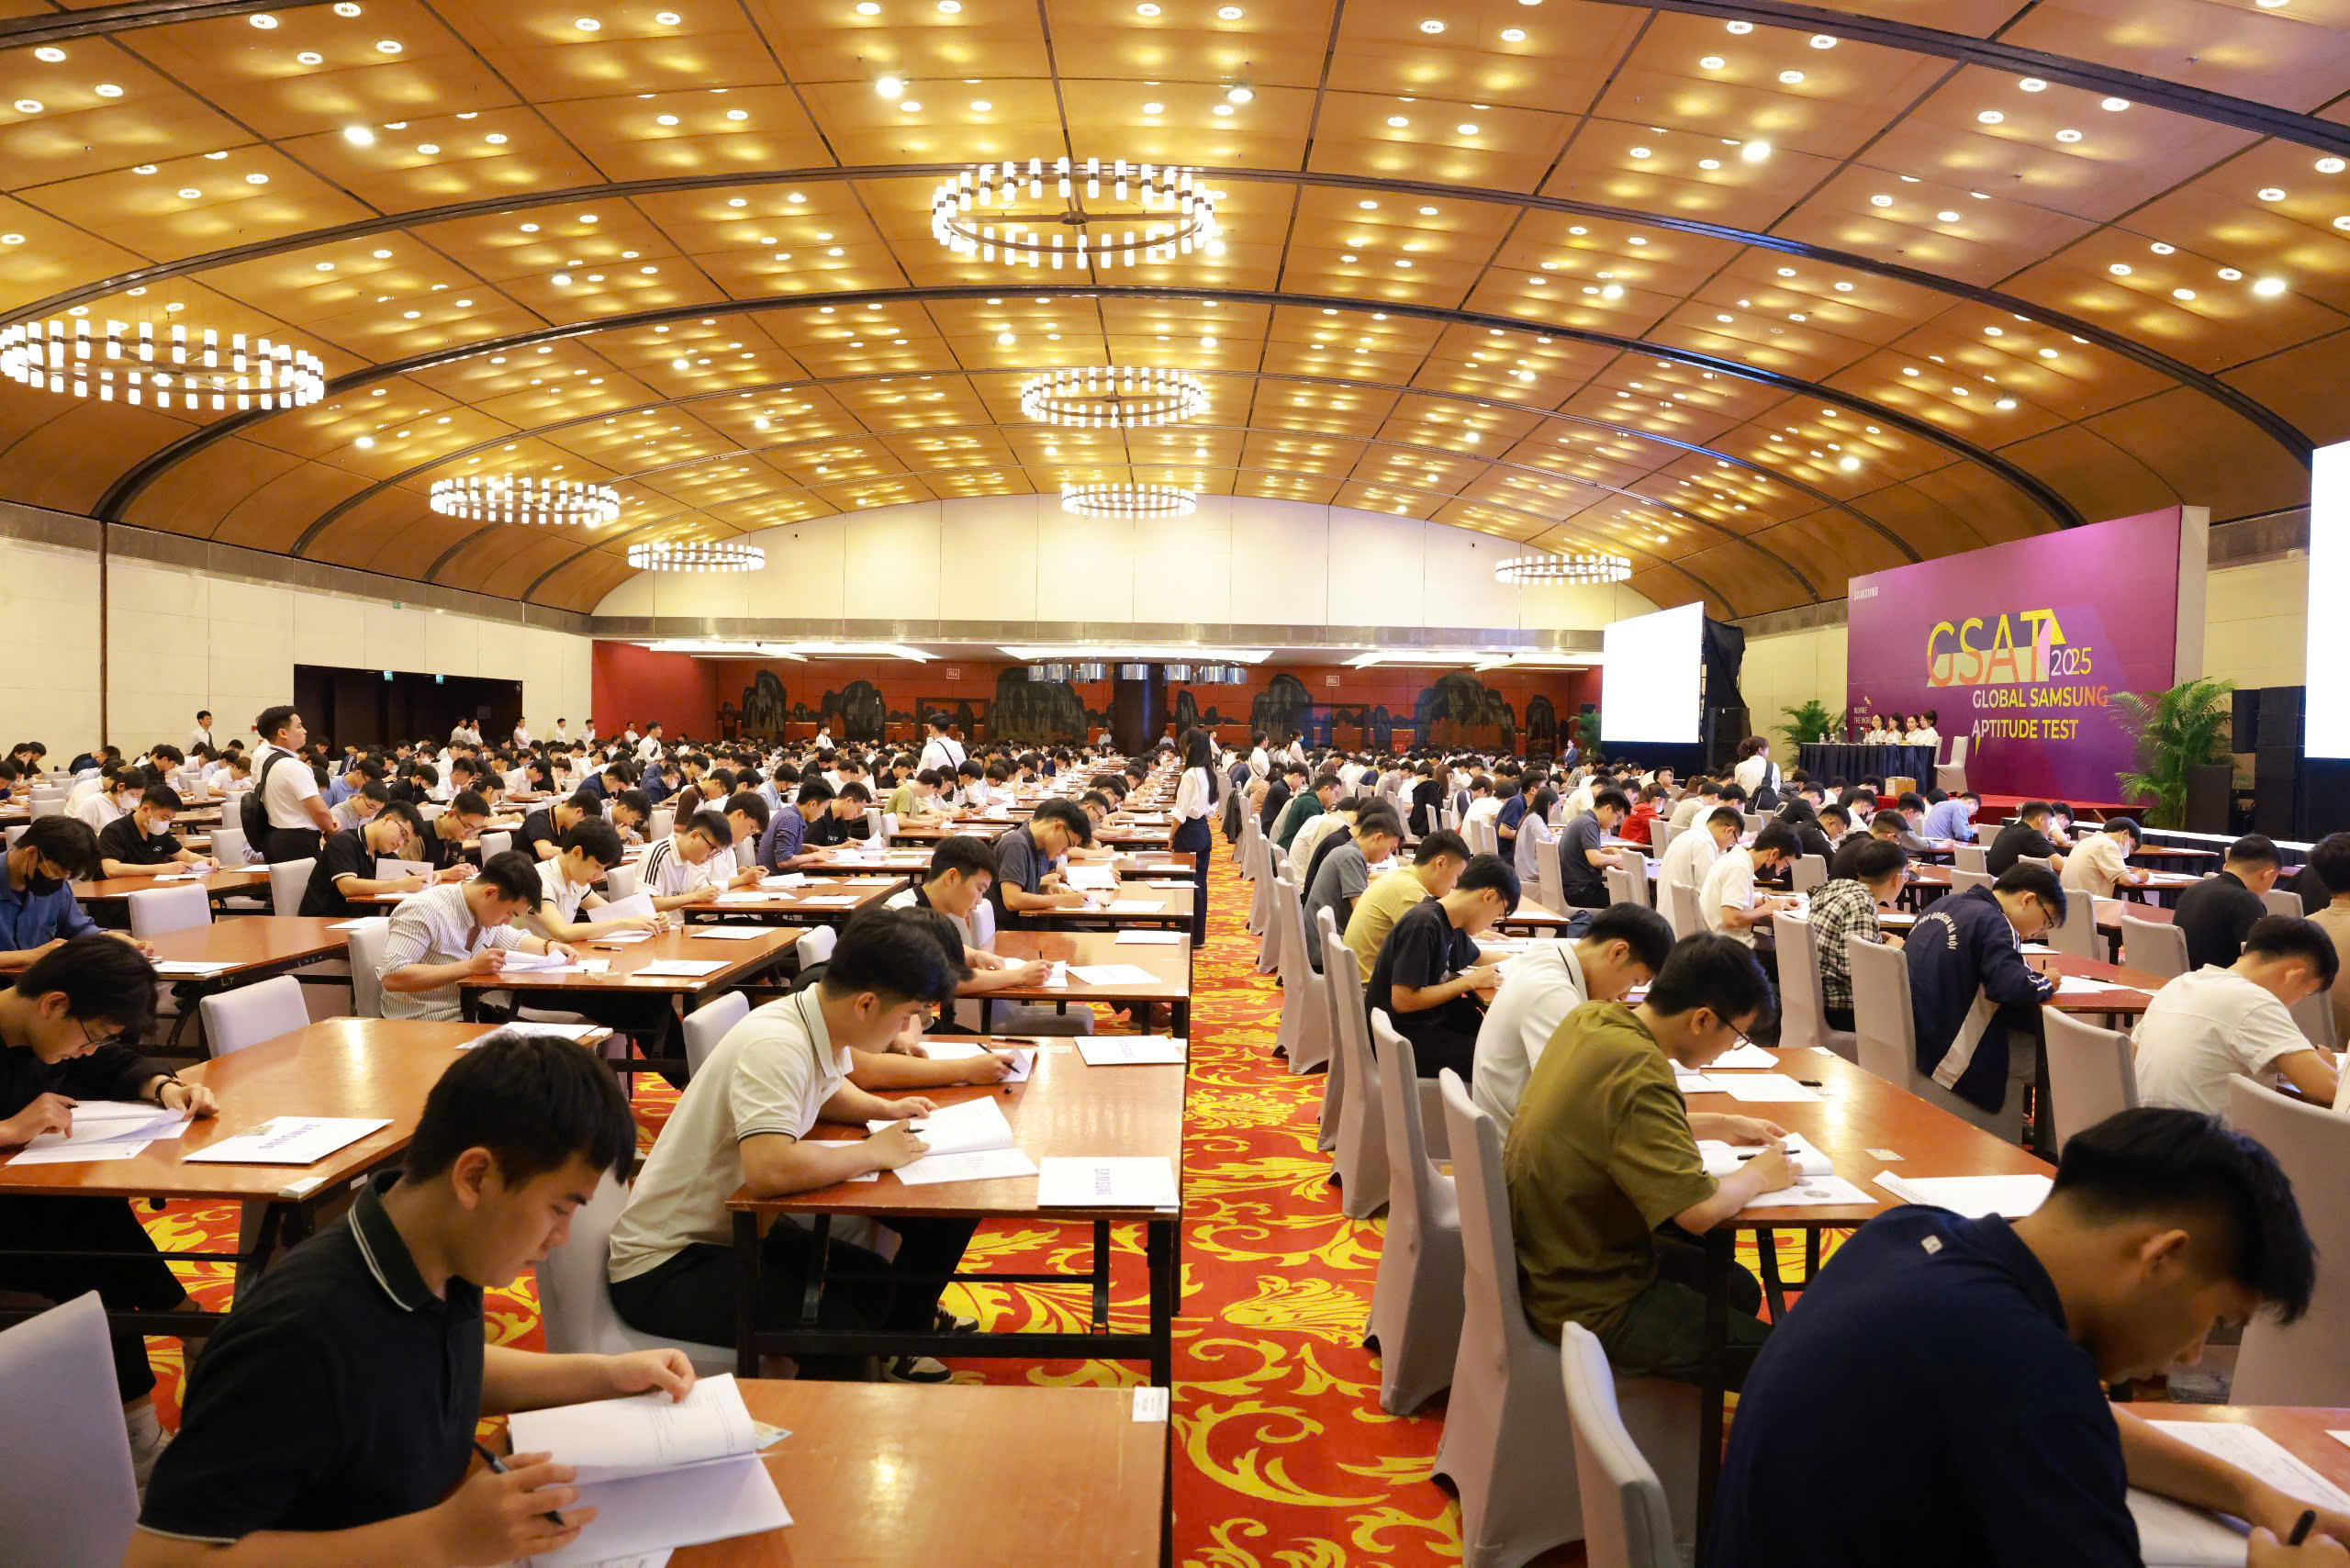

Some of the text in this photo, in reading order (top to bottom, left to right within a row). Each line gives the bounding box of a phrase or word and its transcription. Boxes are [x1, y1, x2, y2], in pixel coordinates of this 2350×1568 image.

[1853, 587, 1879, 600] SAMSUNG
[1927, 609, 2058, 687] GSAT
[2051, 647, 2092, 676] 2025
[1973, 686, 2109, 708] GLOBAL SAMSUNG
[1972, 719, 2079, 739] APTITUDE TEST
[1947, 935, 1958, 949] NỘI
